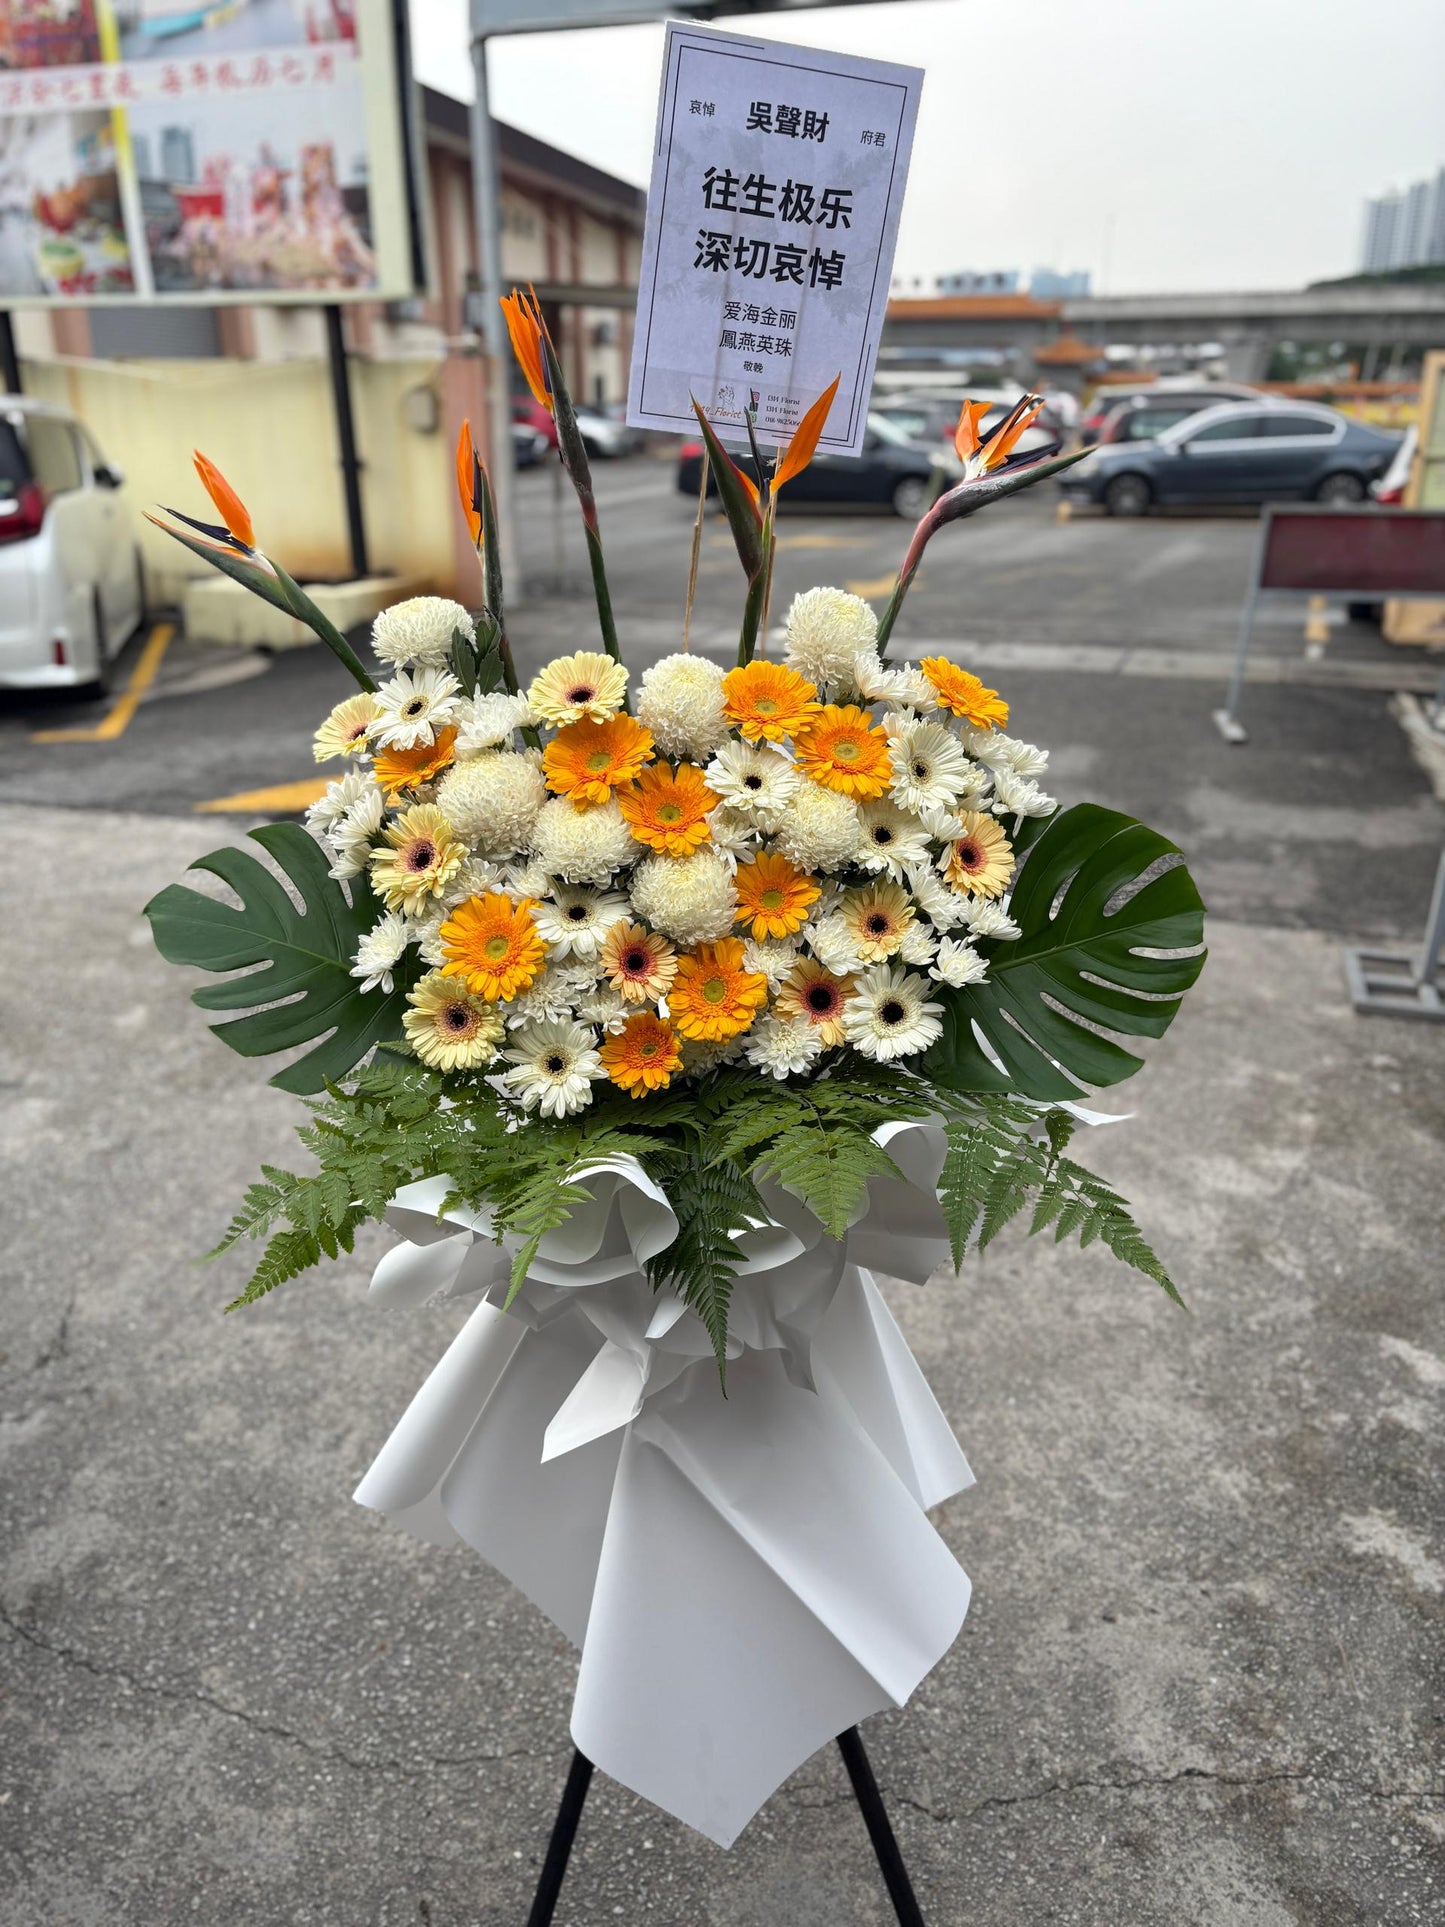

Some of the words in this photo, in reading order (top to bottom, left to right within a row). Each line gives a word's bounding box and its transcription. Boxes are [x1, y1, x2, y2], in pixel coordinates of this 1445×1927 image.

[689, 100, 716, 118] 哀悼
[746, 101, 830, 143] 吳聲財
[860, 129, 886, 148] 府君
[702, 166, 853, 229] 往生极乐
[693, 228, 846, 291] 深切哀悼
[723, 301, 797, 330] 爱海金丽
[719, 329, 792, 357] 鳳燕英珠
